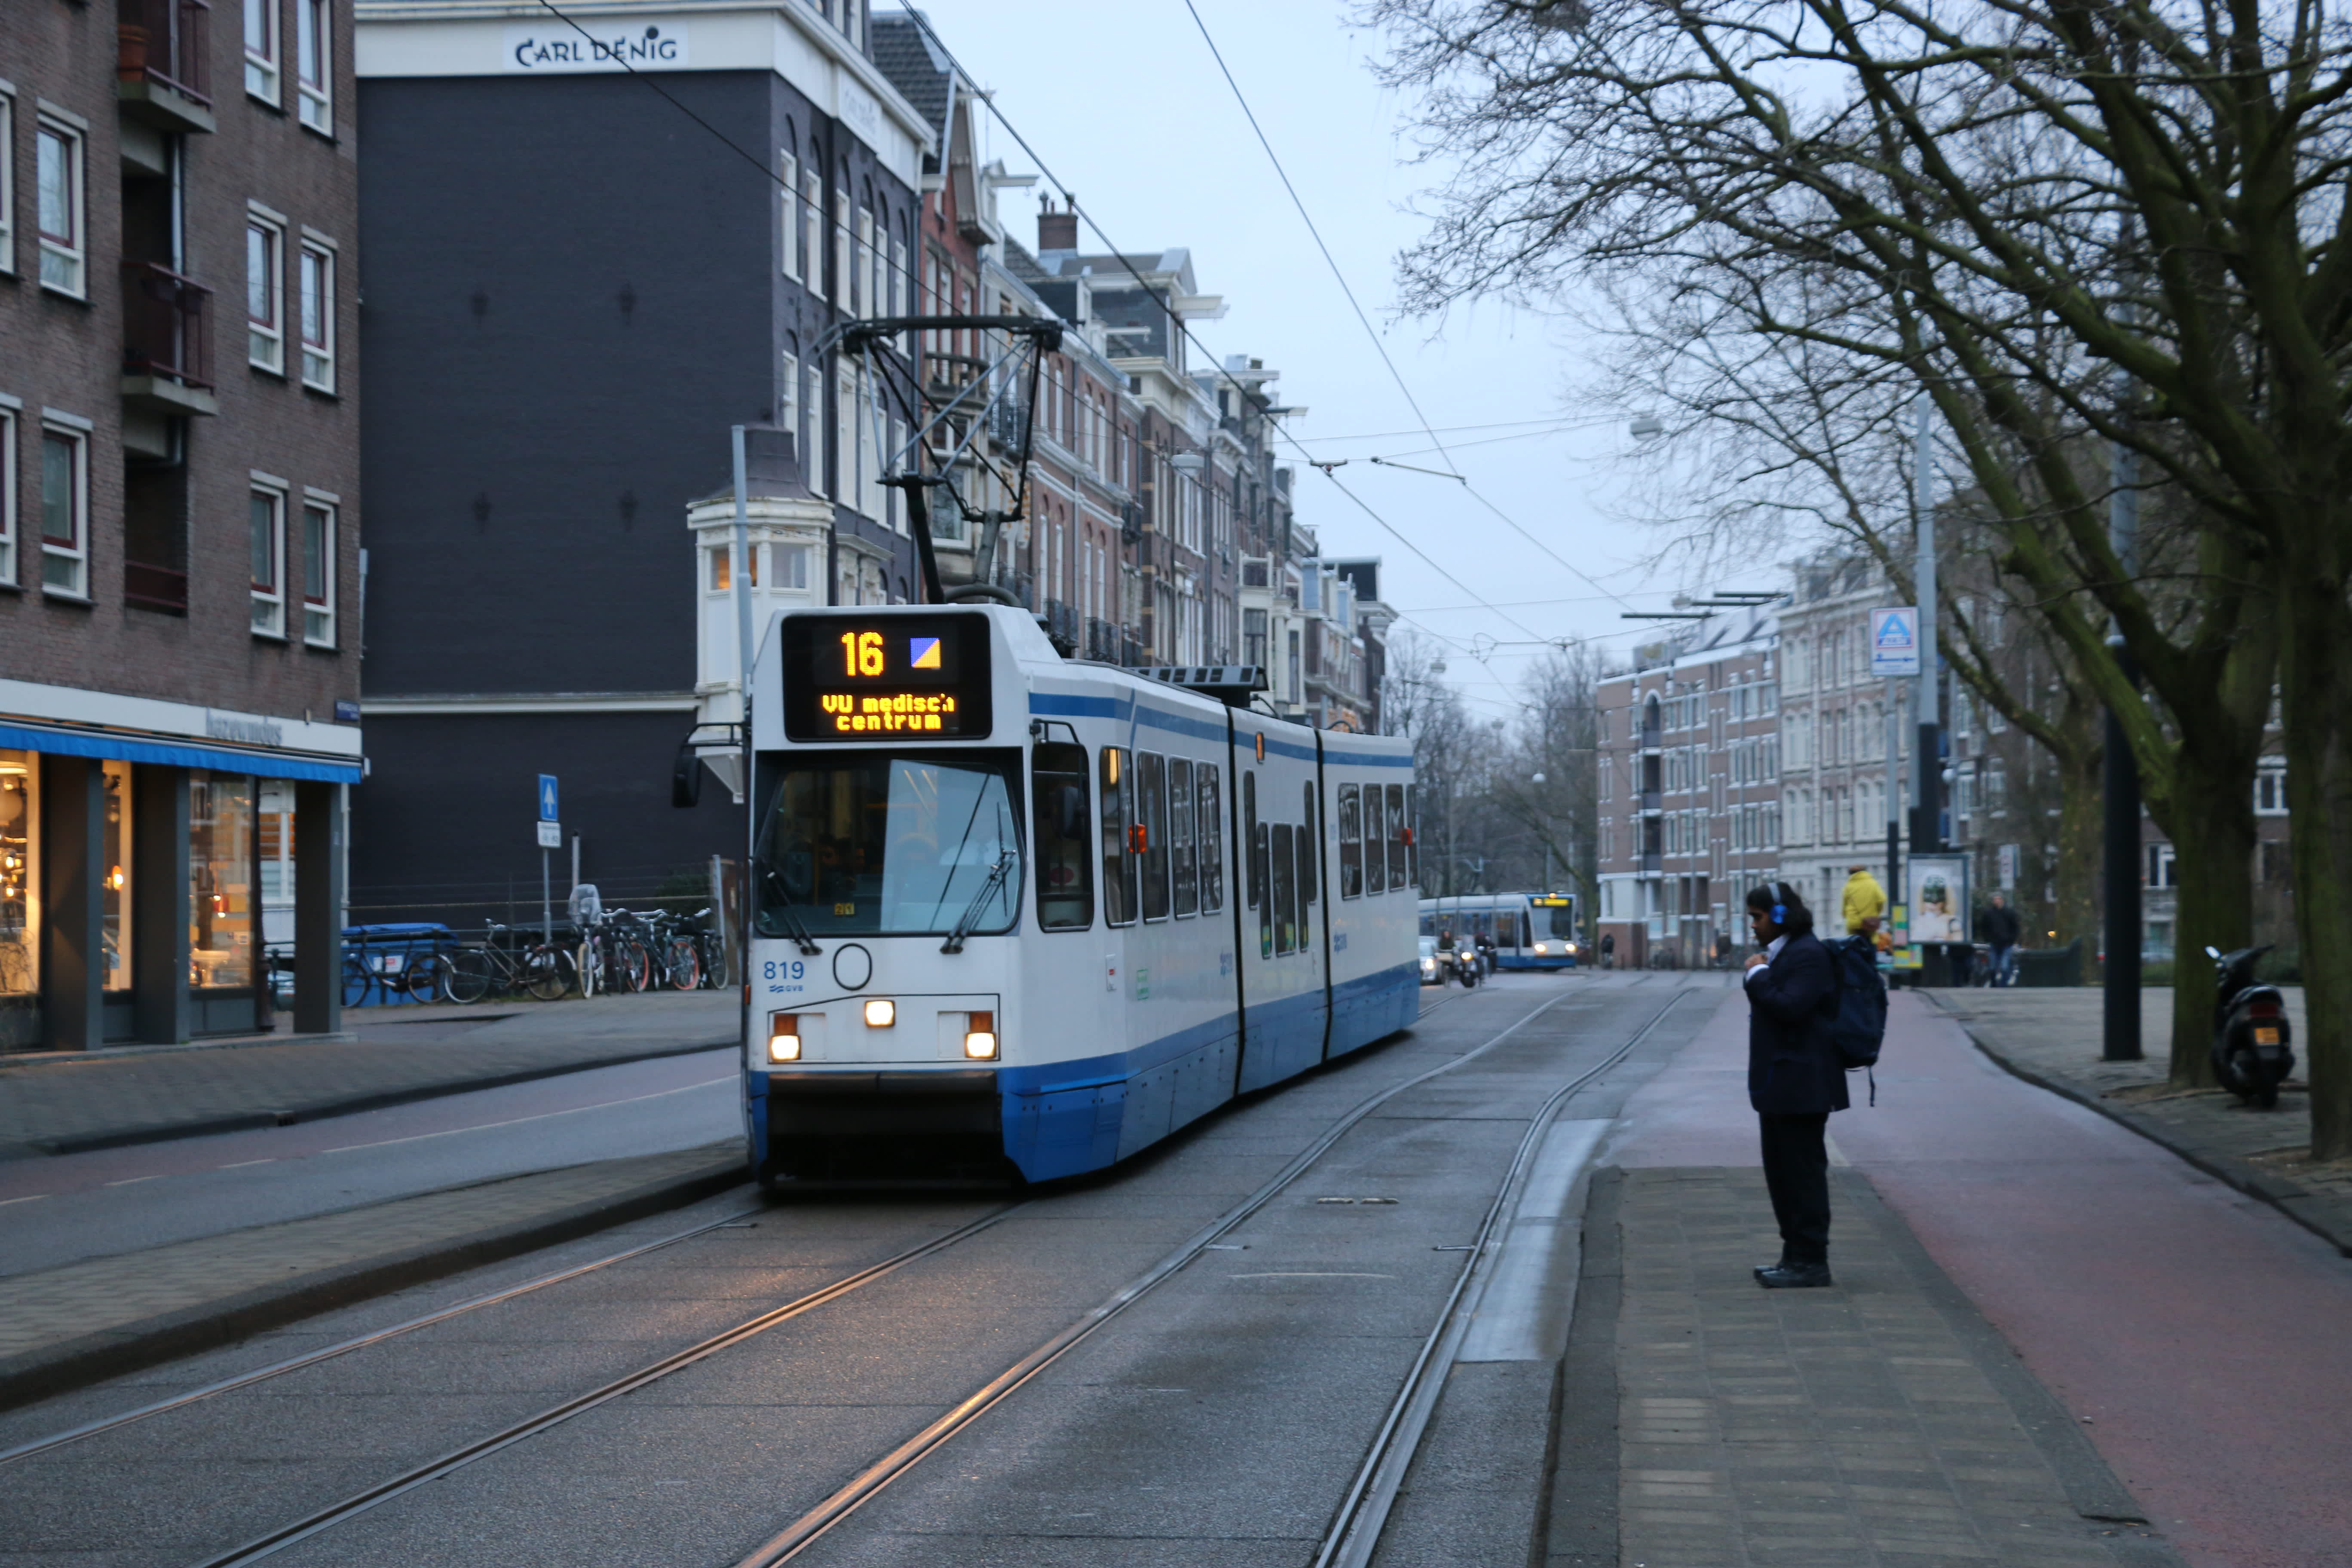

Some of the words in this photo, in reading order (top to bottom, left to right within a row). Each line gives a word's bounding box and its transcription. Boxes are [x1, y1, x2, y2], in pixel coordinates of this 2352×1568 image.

[515, 37, 584, 67] CARL
[841, 631, 884, 676] 16
[822, 694, 853, 713] VU
[837, 711, 941, 731] centrum
[764, 961, 804, 979] 819
